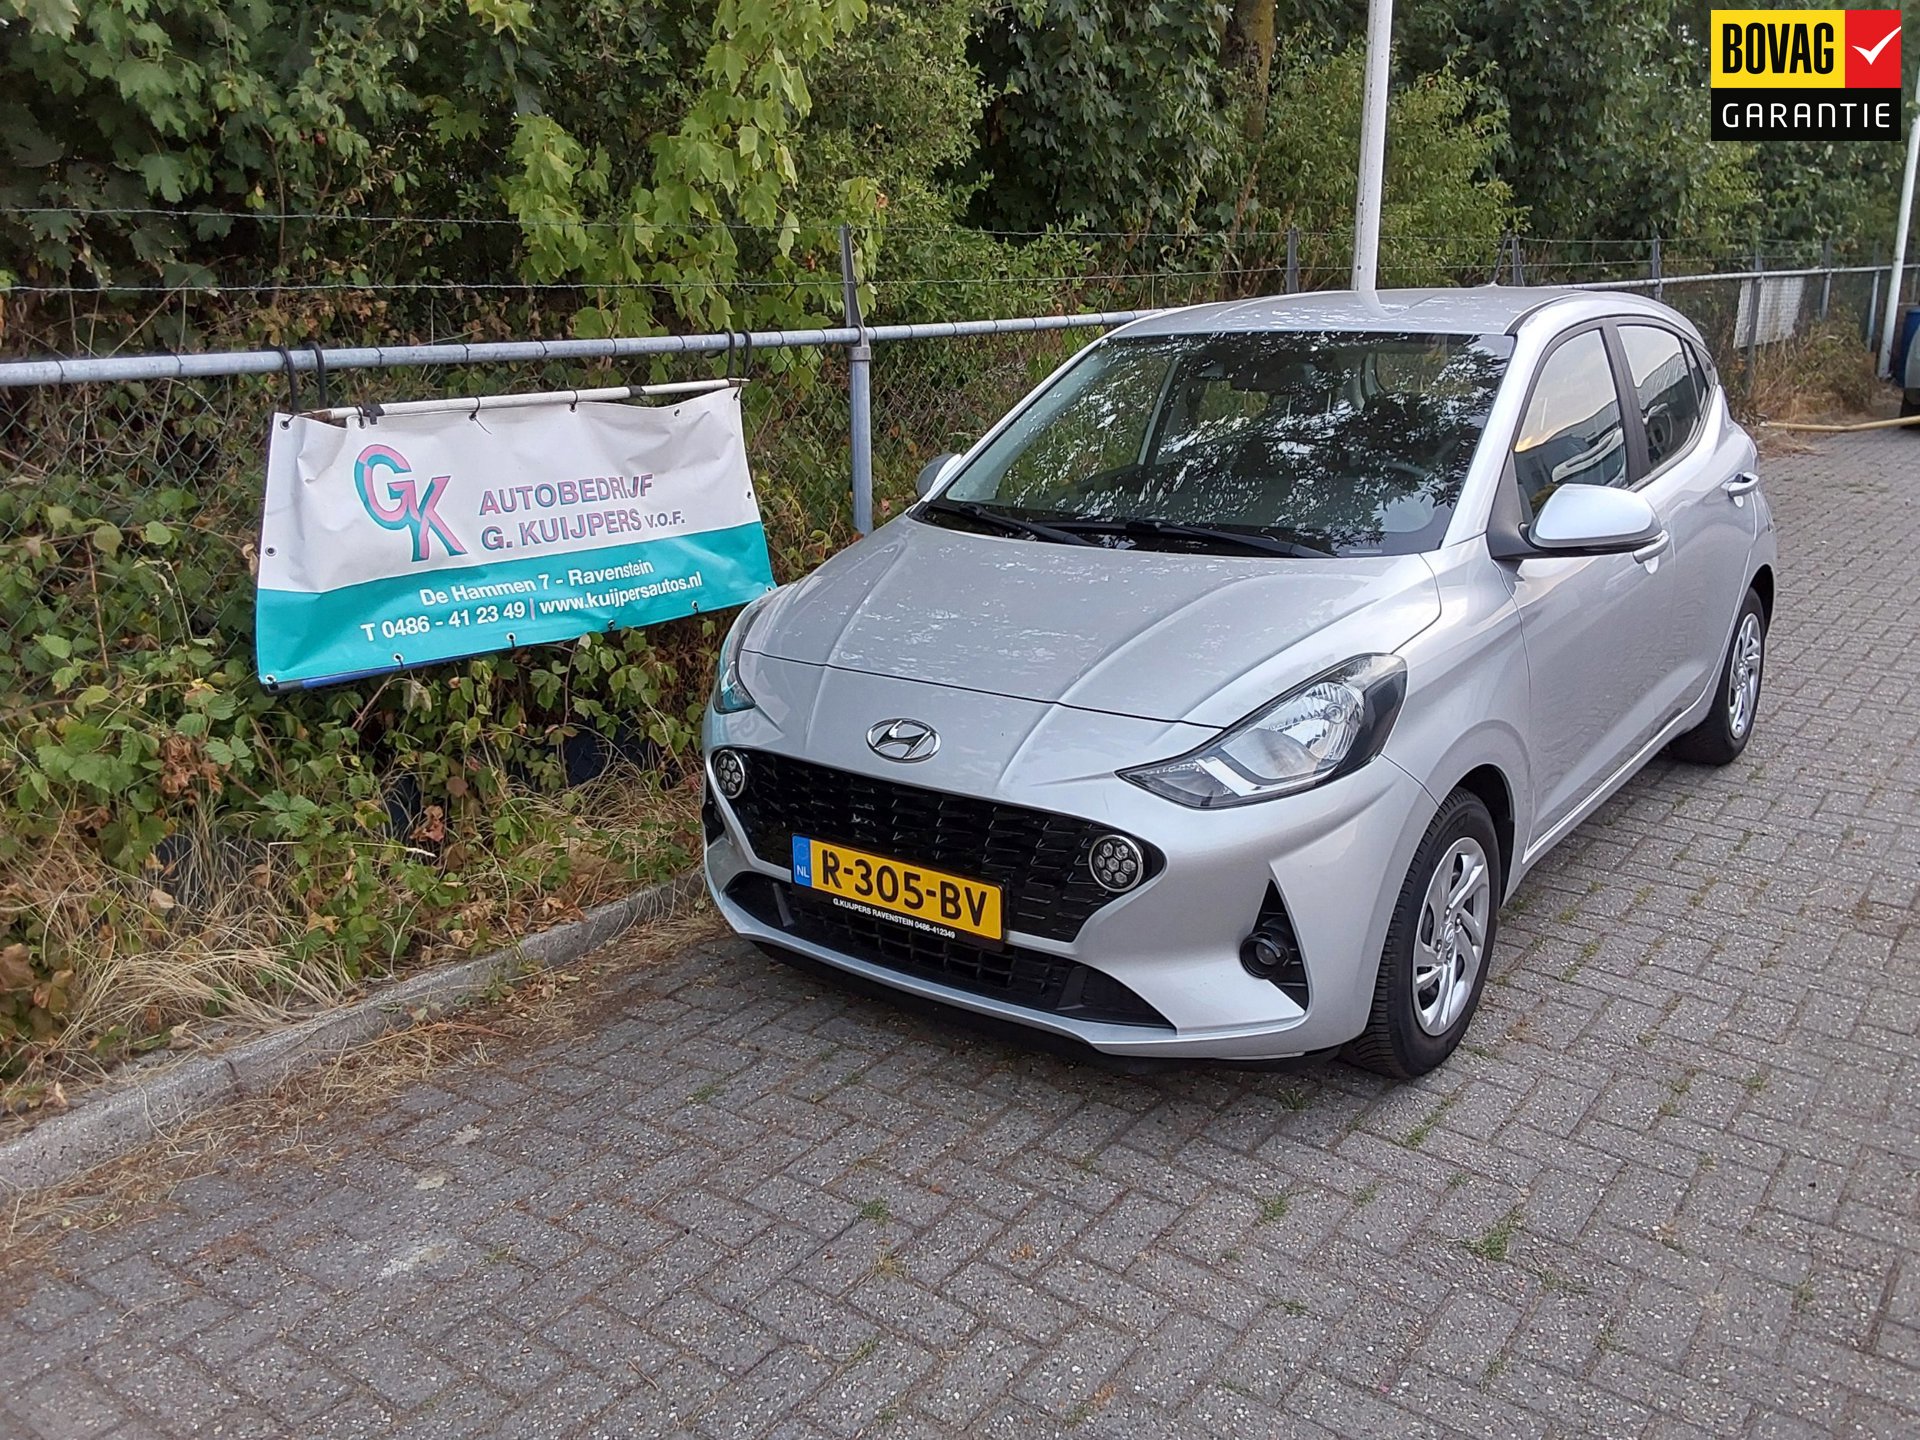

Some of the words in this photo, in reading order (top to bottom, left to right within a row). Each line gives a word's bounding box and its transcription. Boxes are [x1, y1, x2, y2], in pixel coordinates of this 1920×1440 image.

[479, 473, 654, 516] AUTOBEDRIJF
[481, 525, 513, 551] G.
[518, 508, 642, 546] KUIJPERS
[419, 588, 449, 606] De
[450, 579, 537, 602] Hammen
[538, 574, 550, 590] 7
[568, 559, 655, 587] Ravenstein
[360, 623, 376, 642] T
[381, 615, 431, 639] 0486
[448, 610, 471, 628] 41
[476, 605, 499, 625] 23
[503, 601, 526, 619] 49
[539, 571, 703, 615] www.kuijpersautos.nl
[796, 864, 810, 878] NL
[821, 849, 988, 927] R-305-BV
[872, 908, 914, 927] RAVENSTEIN
[914, 921, 956, 939] 0486-412349
